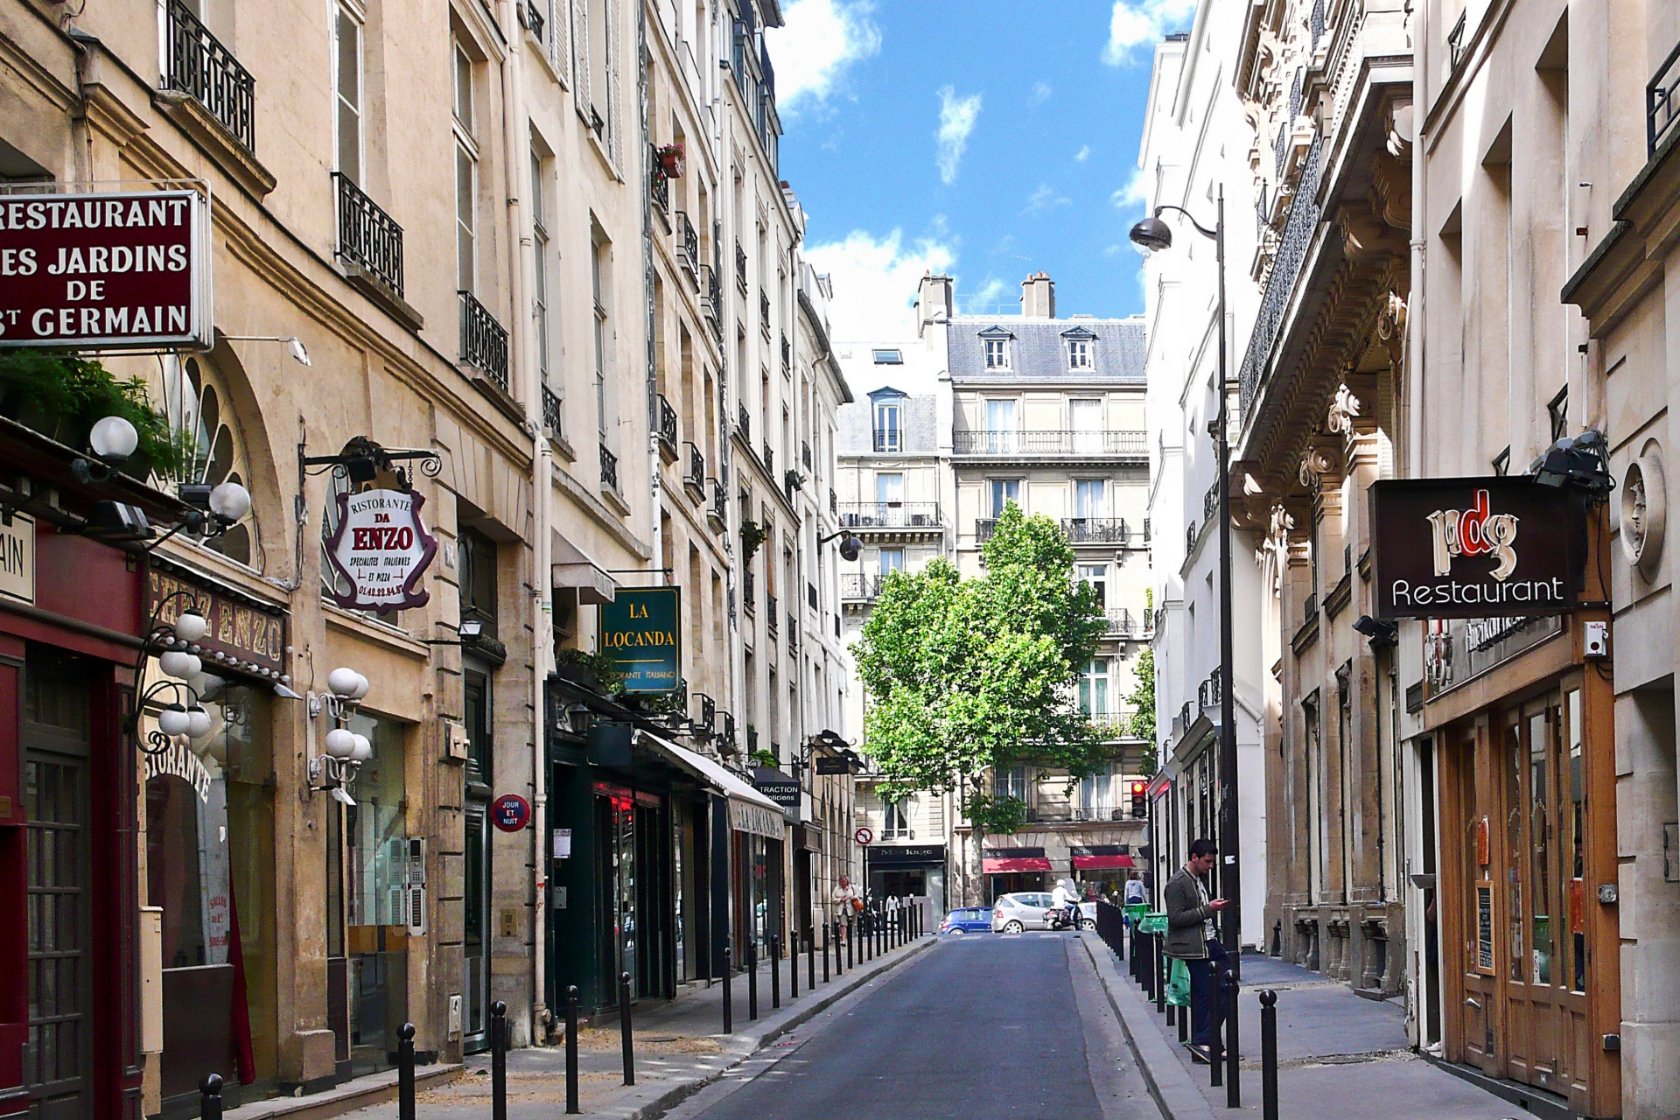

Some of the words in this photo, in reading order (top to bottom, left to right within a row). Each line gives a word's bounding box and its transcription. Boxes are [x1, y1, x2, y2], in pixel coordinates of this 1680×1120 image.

[0, 200, 188, 230] ESTAURANT
[0, 248, 38, 276] ES
[47, 244, 188, 275] JARDINS
[66, 280, 106, 301] DE
[0, 309, 21, 336] T
[31, 305, 187, 336] GERMAIN
[351, 499, 411, 514] RISTORANTE
[374, 513, 391, 523] DA
[352, 527, 413, 550] ENZO
[1426, 488, 1520, 581] pdg
[368, 572, 375, 582] ET
[376, 572, 391, 582] PIZZA
[1392, 577, 1564, 607] Restaurant
[629, 603, 649, 619] LA
[218, 598, 281, 662] ENZO
